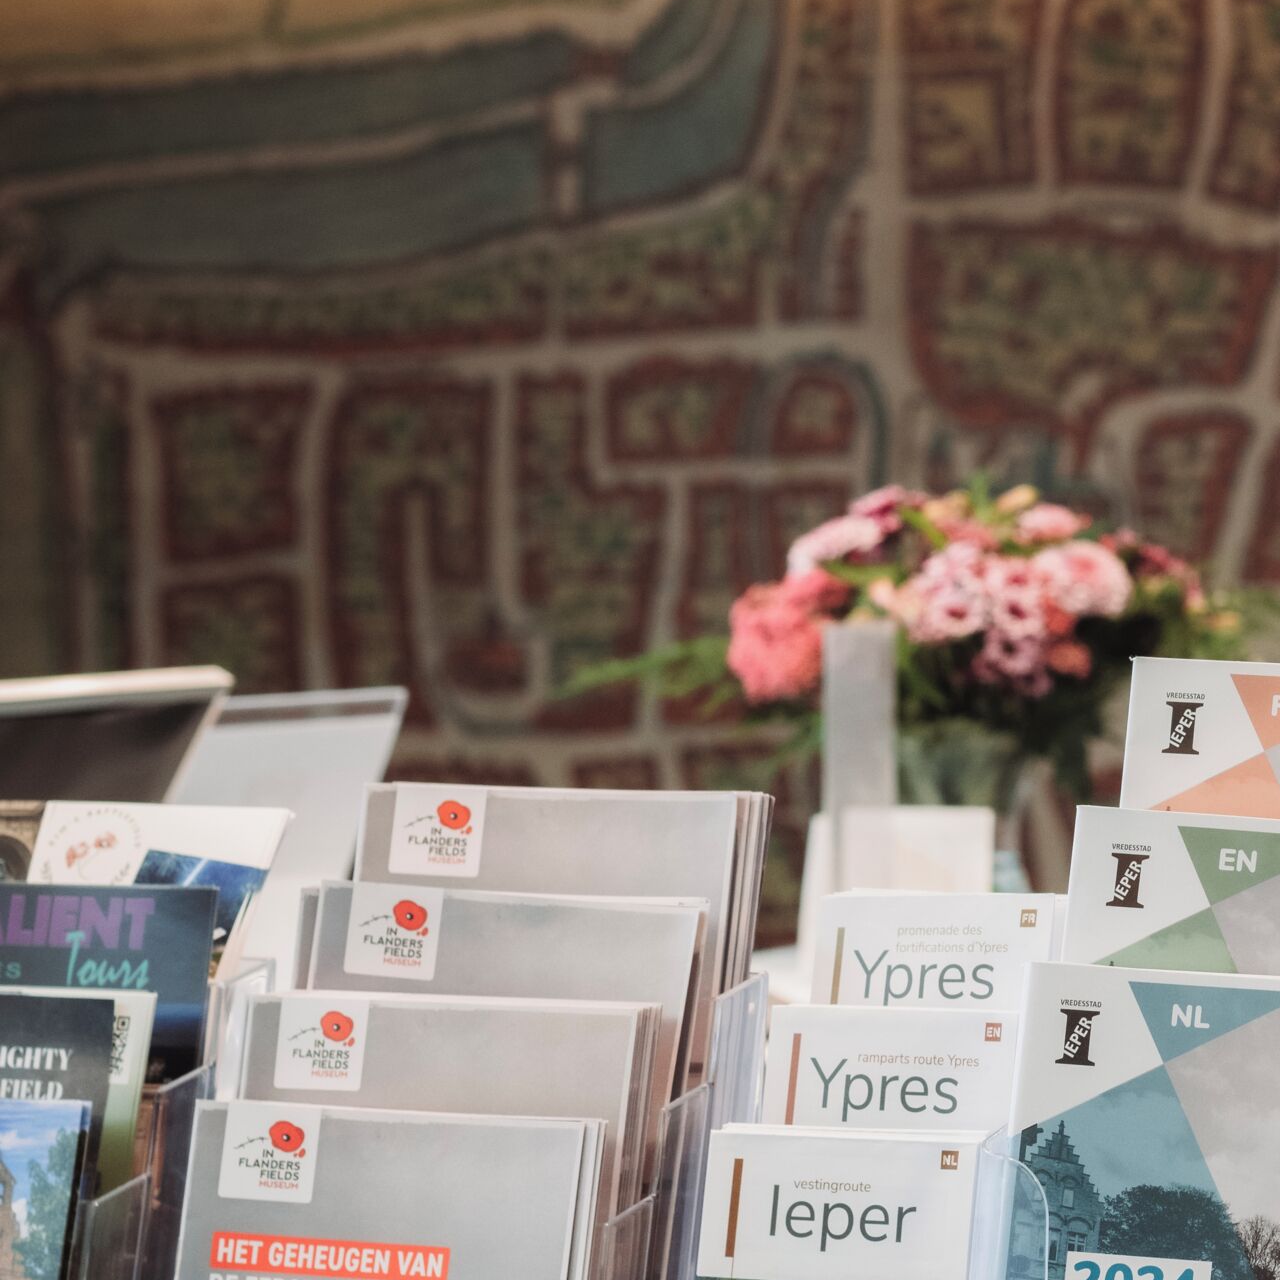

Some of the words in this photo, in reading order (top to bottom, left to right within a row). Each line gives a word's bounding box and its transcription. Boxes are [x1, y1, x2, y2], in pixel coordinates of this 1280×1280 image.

[1166, 692, 1205, 700] VREDESSTAD
[1169, 708, 1196, 748] IEPER
[408, 836, 467, 846] FLANDERS
[1112, 843, 1151, 852] VREDESSTAD
[429, 847, 466, 856] FIELDS
[1219, 848, 1257, 873] EN
[1114, 860, 1142, 901] IEPER
[0, 894, 155, 950] LIENT
[897, 924, 958, 938] promenade
[963, 924, 983, 936] des
[363, 935, 423, 948] FLANDERS
[896, 941, 965, 953] fortifications
[384, 947, 422, 958] FIELDS
[66, 931, 150, 989] Tours
[854, 949, 994, 1006] Ypres
[1061, 999, 1102, 1008] VREDESSTAD
[1171, 1004, 1210, 1028] NL
[985, 1026, 1001, 1039] EN
[1063, 1017, 1092, 1058] IEPER
[293, 1049, 349, 1059] FLANDERS
[857, 1052, 910, 1066] ramparts
[914, 1054, 944, 1066] route
[947, 1055, 980, 1069] Ypres
[312, 1060, 348, 1069] FIELDS
[0, 1078, 63, 1100] FIELD
[811, 1057, 958, 1122] Ypres
[263, 1149, 273, 1158] IN
[239, 1158, 300, 1170] FLANDERS
[942, 1154, 958, 1167] NL
[260, 1170, 299, 1180] FIELDS
[259, 1180, 298, 1189] MUSEUM
[793, 1179, 871, 1194] vestingroute
[769, 1184, 917, 1252] Ieper
[217, 1238, 263, 1265] HET
[268, 1242, 390, 1274] GEHEUGEN
[397, 1250, 444, 1277] VAN
